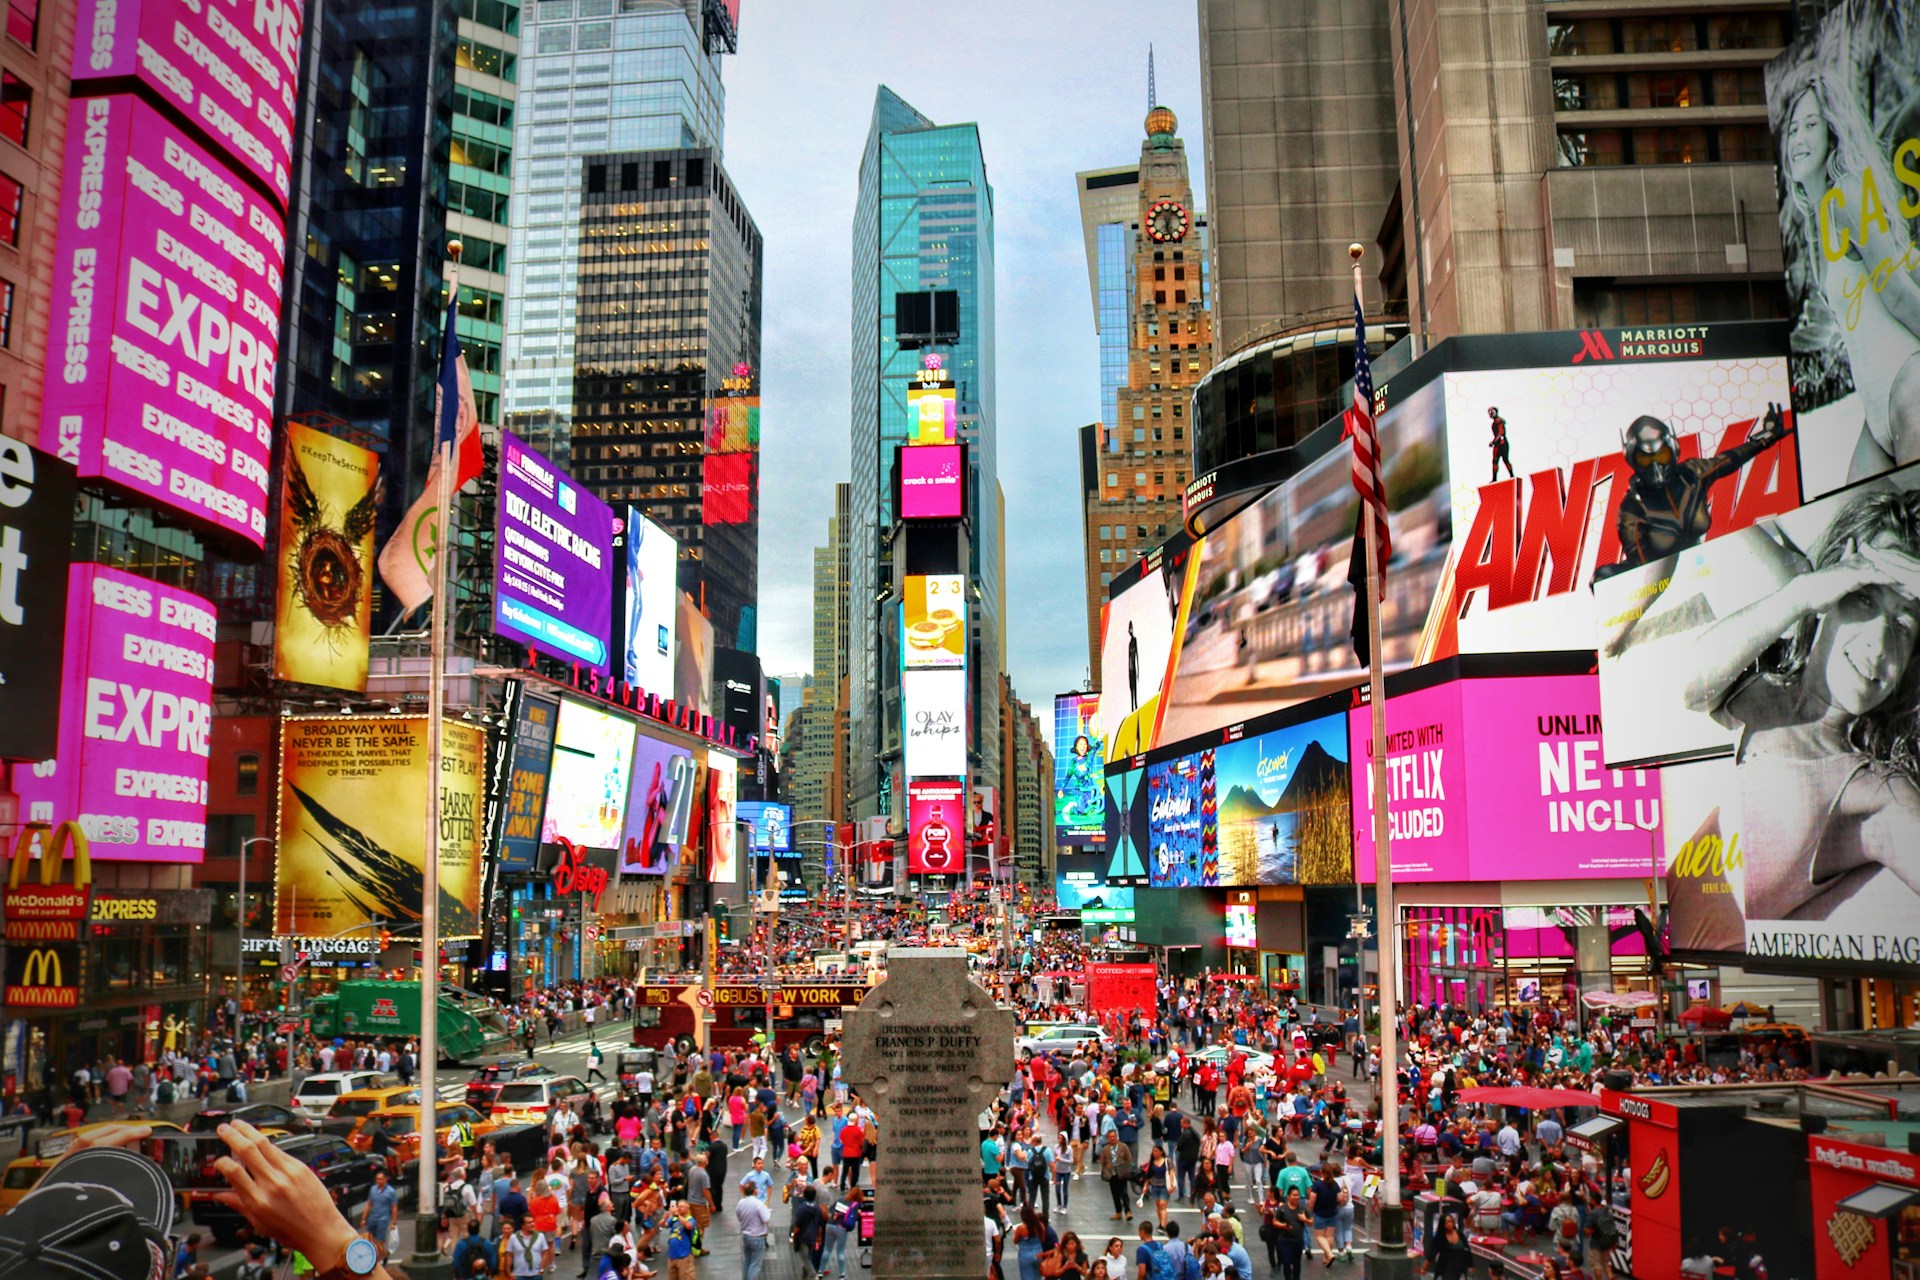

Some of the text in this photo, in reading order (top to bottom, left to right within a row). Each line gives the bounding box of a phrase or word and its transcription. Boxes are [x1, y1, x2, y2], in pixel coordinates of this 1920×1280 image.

[206, 4, 281, 91] EXPRESS
[173, 20, 253, 109] EXPRESS
[199, 93, 274, 174] EXPRESS
[76, 98, 110, 230] EXPRESS
[163, 137, 245, 218] EXPRESS
[190, 203, 265, 277] EXPRESS
[156, 229, 238, 303] EXPRESS
[63, 248, 97, 384] EXPRESS
[1621, 327, 1709, 343] MARRIOTT
[1622, 341, 1700, 356] MARQUIS
[916, 369, 948, 382] 2018
[176, 371, 254, 434] EXPRESS
[142, 403, 227, 466] EXPRESS
[300, 444, 369, 478] #KeepTheSecrets
[903, 476, 926, 485] crack
[935, 475, 957, 485] smile
[1187, 472, 1218, 497] MARRIOTT
[169, 468, 249, 525] EXPRESS
[1187, 486, 1215, 509] MARQUIS
[531, 506, 573, 552] ELECTRIC
[123, 633, 206, 680] EXPRESS
[572, 661, 631, 705] 1540
[636, 686, 736, 746] BROADWAY
[84, 677, 212, 758] EXPRE
[379, 723, 410, 735] WILL
[910, 715, 960, 741] whips
[915, 710, 955, 724] OLAY
[292, 736, 419, 749] NEVER BE THE SAME.
[1417, 723, 1444, 748] WITH
[297, 758, 411, 768] REDEFINES THE POSSIBILITIES
[307, 749, 354, 758] THEATRICAL
[356, 749, 388, 758] MARVEL
[390, 748, 411, 757] THAT
[327, 768, 338, 776] OF
[441, 756, 478, 776] EST PLAY
[115, 768, 199, 806] EXPRESS
[513, 769, 545, 795] COME
[1366, 749, 1446, 811] NTFLIX
[504, 814, 539, 840] AWAY
[1371, 807, 1444, 843] ICLUDED
[1548, 799, 1660, 833] INCLU
[440, 817, 477, 843] OTTER
[927, 828, 946, 837] POM
[6, 895, 84, 907] McDonald's
[18, 907, 70, 916] Restaurant
[91, 899, 157, 920] EXPRESS
[241, 938, 381, 954] GIFTS LUGGAGE
[1749, 933, 1920, 963] AMERICAN EAG
[310, 960, 334, 968] SONY
[714, 989, 840, 1004] IGBUS NW YORK
[875, 1036, 924, 1048] FRANCIS
[941, 1036, 981, 1048] DUFFY
[882, 1025, 971, 1034] LIEUTENANT COLONEL
[888, 1063, 968, 1073] CATHOLIC PRIEST
[907, 1085, 949, 1093] CHAPLAIN
[900, 1130, 918, 1138] LIFE
[934, 1130, 968, 1138] SERVICE
[886, 1146, 971, 1154] GOD AND COUNTRY
[1815, 1146, 1915, 1180] belgian waffles
